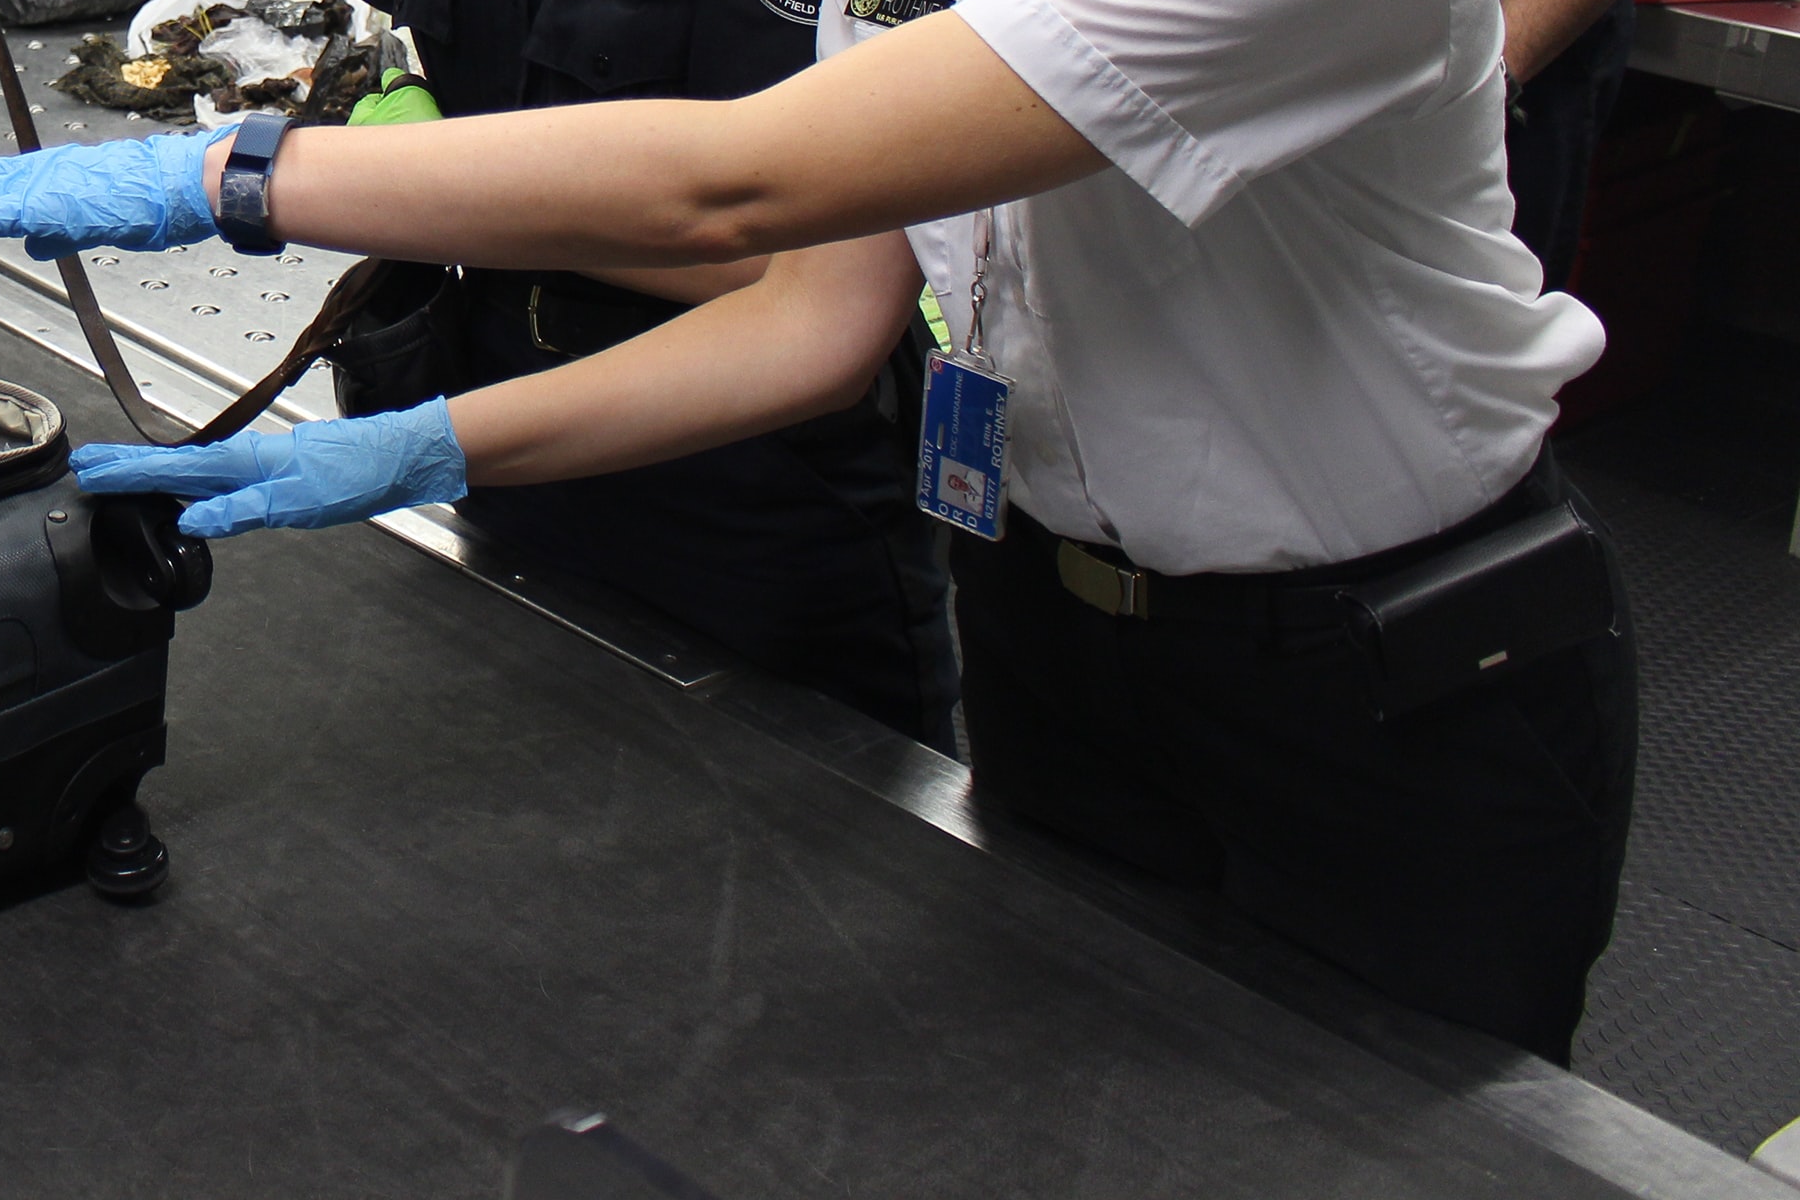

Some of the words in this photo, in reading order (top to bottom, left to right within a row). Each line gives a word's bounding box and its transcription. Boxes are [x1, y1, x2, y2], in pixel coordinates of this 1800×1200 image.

[784, 0, 816, 16] FIELD
[951, 371, 964, 435] QUARANTINE
[985, 407, 993, 417] E
[983, 422, 993, 448] ERIN
[990, 391, 1006, 469] ROTHNEY
[922, 439, 935, 471] 2017
[949, 432, 959, 458] CDC
[920, 472, 934, 497] Apr
[985, 477, 997, 520] 621777
